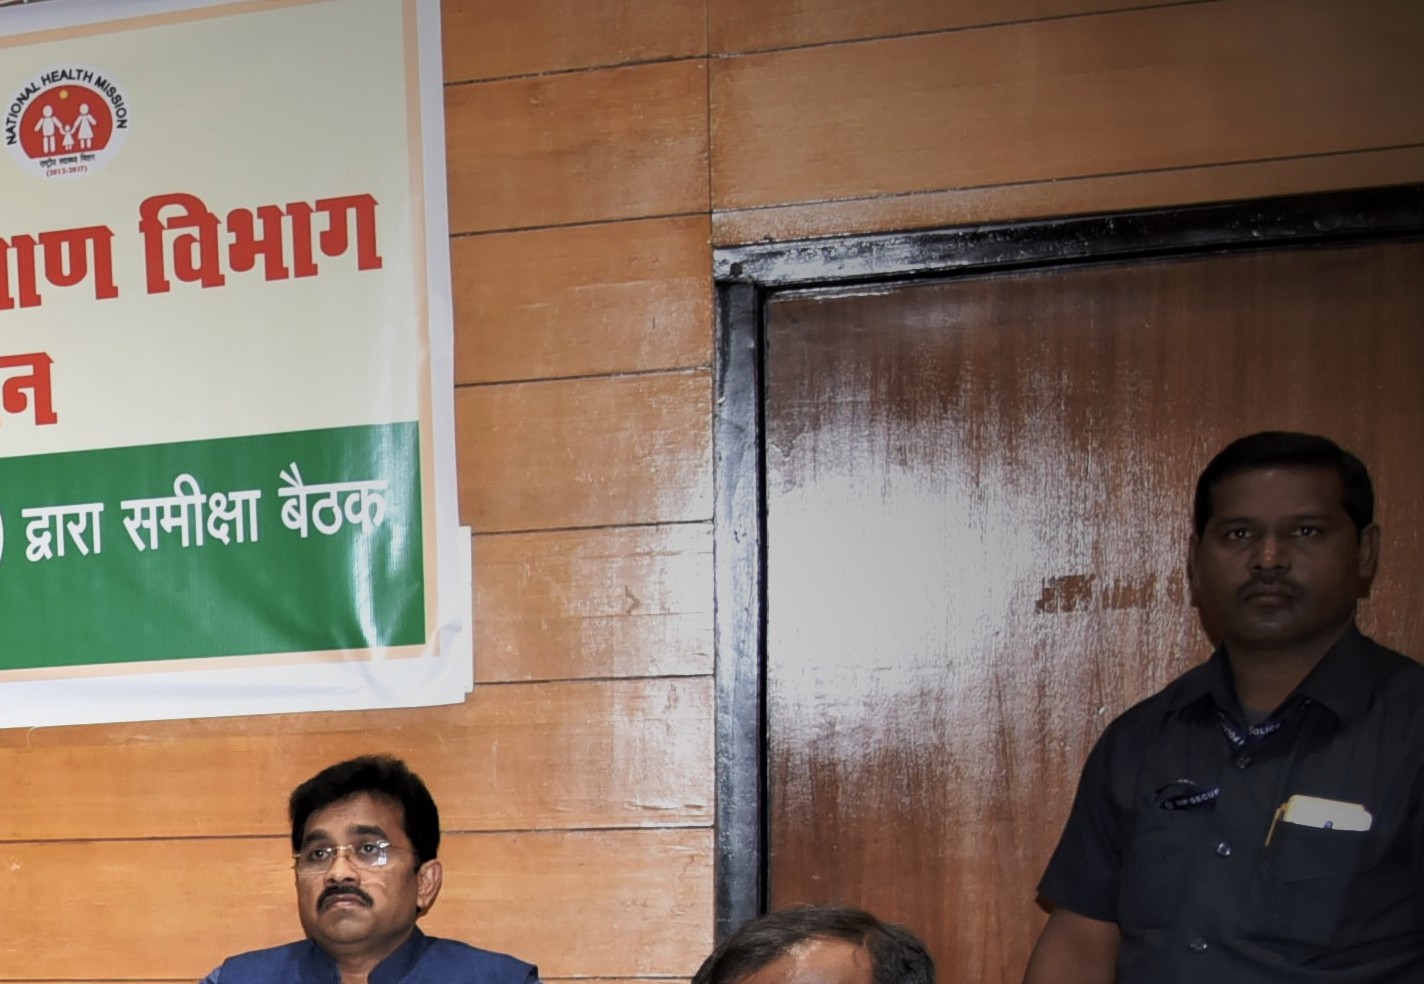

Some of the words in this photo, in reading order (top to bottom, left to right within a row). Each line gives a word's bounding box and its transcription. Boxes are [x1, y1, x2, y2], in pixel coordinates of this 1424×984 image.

[5, 81, 41, 146] NATIONAL
[41, 68, 94, 86] HEALTH
[94, 75, 128, 129] MISSION
[139, 192, 383, 295] विभाग
[21, 502, 104, 562] द्वारा
[121, 473, 261, 551] समीक्षा
[277, 462, 388, 539] बैठक
